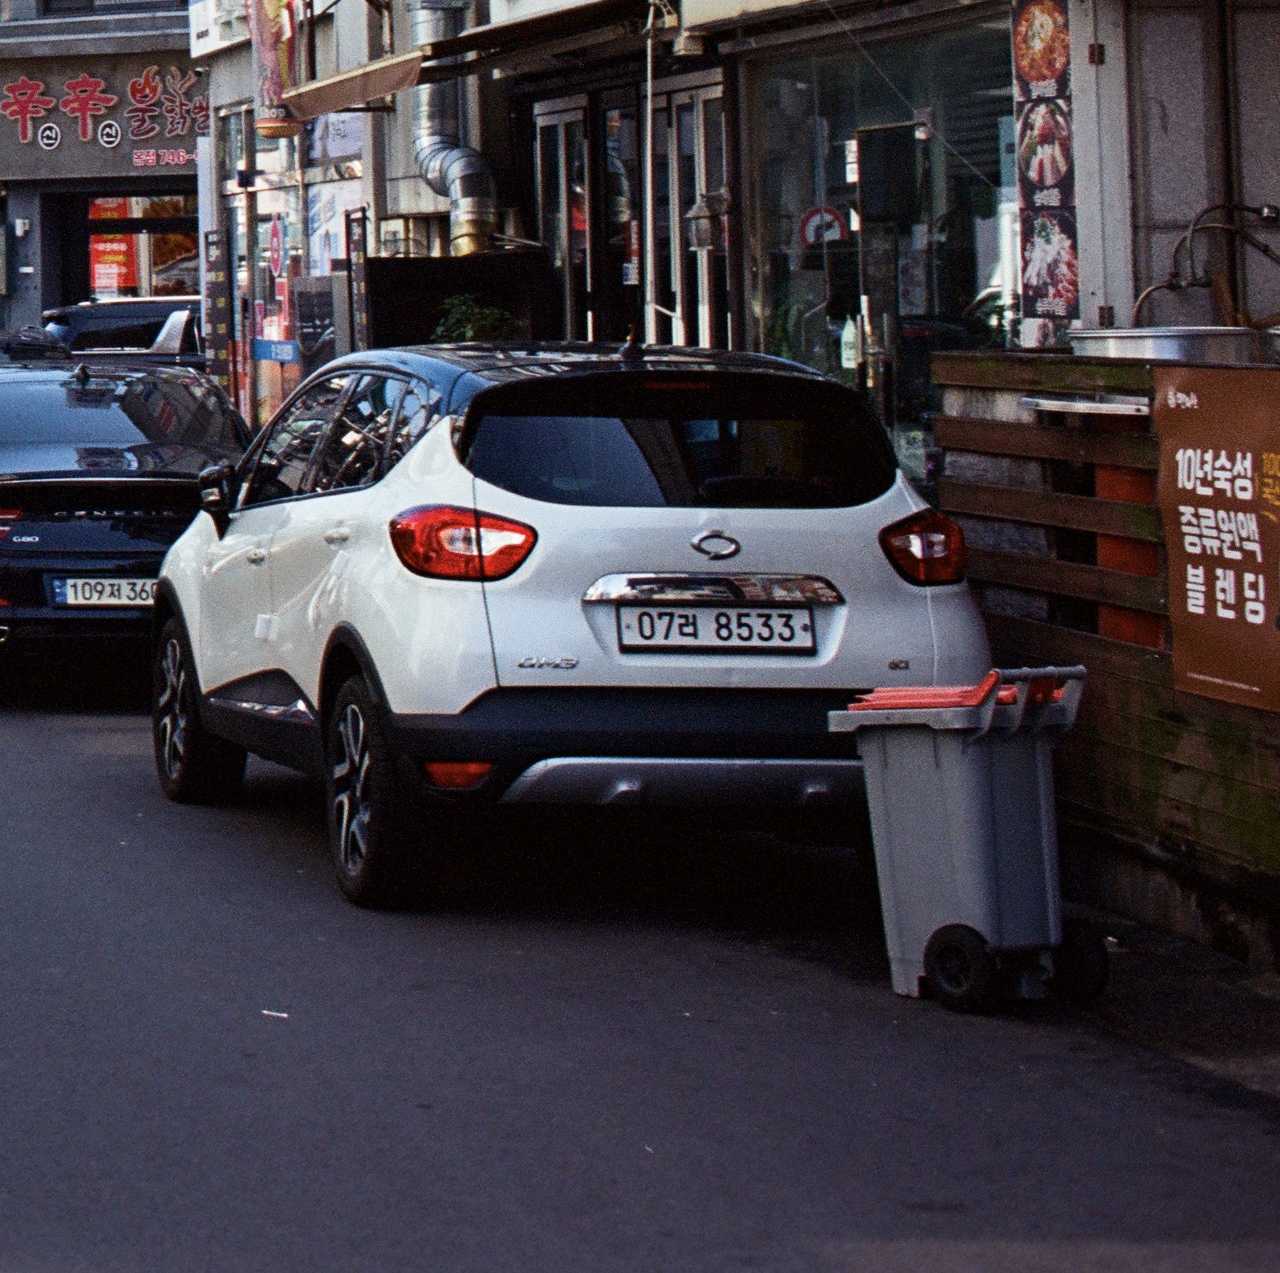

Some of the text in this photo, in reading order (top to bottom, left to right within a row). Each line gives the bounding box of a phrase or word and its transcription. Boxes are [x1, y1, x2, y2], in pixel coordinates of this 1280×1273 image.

[40, 126, 58, 147] 신
[101, 123, 119, 145] 신
[1175, 447, 1253, 501] 10년숙성
[12, 535, 40, 543] G80
[1178, 504, 1263, 563] 증류원액
[69, 580, 159, 601] 109저 360
[1185, 564, 1266, 625] 블렌딩
[715, 613, 797, 643] 8533
[516, 656, 580, 670] QM3
